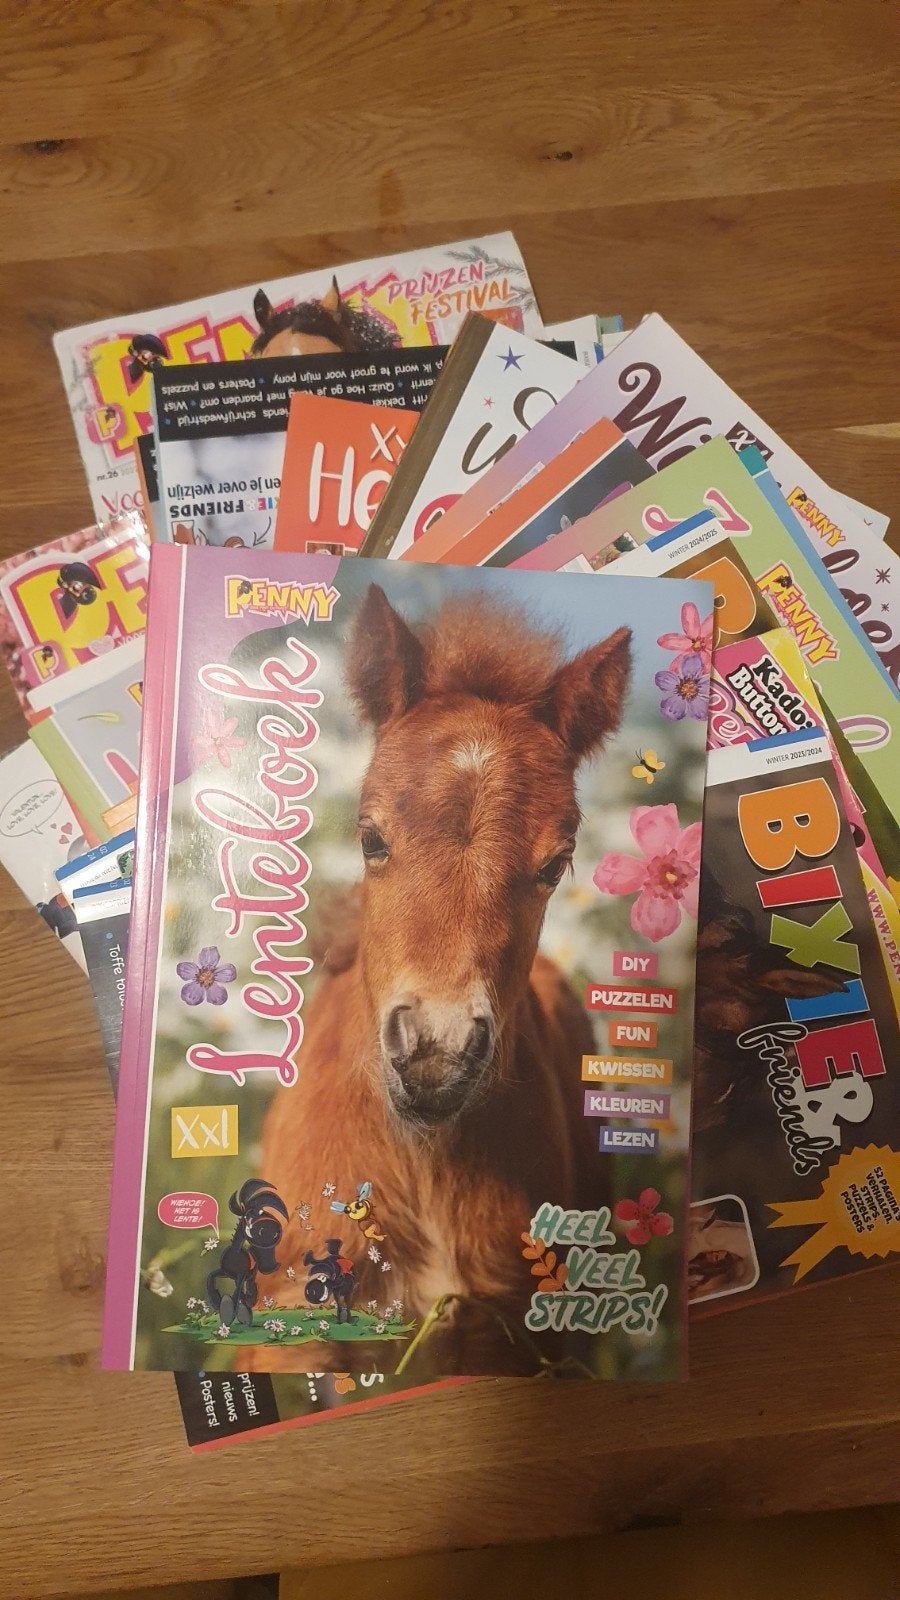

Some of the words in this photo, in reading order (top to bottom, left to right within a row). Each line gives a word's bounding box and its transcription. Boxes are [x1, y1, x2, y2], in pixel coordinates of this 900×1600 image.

[411, 277, 517, 325] FESTIVAL
[325, 371, 346, 380] voor
[350, 365, 377, 379] groot
[380, 367, 391, 376] te
[395, 364, 420, 375] word
[423, 363, 432, 372] ik
[219, 379, 255, 389] Posters
[273, 372, 297, 384] pony
[300, 371, 322, 383] mijn
[161, 382, 199, 395] puzzels
[317, 386, 328, 396] je
[331, 384, 343, 395] ga
[346, 385, 366, 394] Hoe
[369, 382, 395, 392] Quiz:
[199, 398, 220, 408] om?
[222, 392, 263, 405] paarden
[266, 392, 286, 402] met
[163, 401, 188, 412] Wist
[178, 411, 256, 427] schrijfwedstrijd
[167, 483, 215, 500] welzijn
[218, 481, 247, 494] over
[250, 477, 262, 493] je
[786, 486, 846, 548] PENNY
[668, 543, 690, 560] WINTER
[226, 576, 340, 625] PENNY
[756, 563, 838, 665] PENNY
[765, 754, 789, 765] WINTER
[188, 637, 322, 1086] Lenteboek
[109, 944, 125, 975] Toffe
[622, 956, 650, 972] DIY
[591, 990, 673, 1009] PUZZELEN
[616, 1025, 650, 1042] FUN
[588, 1060, 665, 1079] KWISSEN
[590, 1096, 664, 1114] KLEUREN
[603, 1131, 655, 1148] LEZEN
[173, 1215, 203, 1223] LENTE!
[531, 1206, 613, 1243] HEEL
[866, 1223, 875, 1232] &
[566, 1250, 642, 1287] VEEL
[528, 1287, 666, 1332] STRIPS!
[221, 1381, 238, 1422] nieuws
[237, 1373, 260, 1417] prijzen!
[200, 1380, 220, 1428] Posters!
